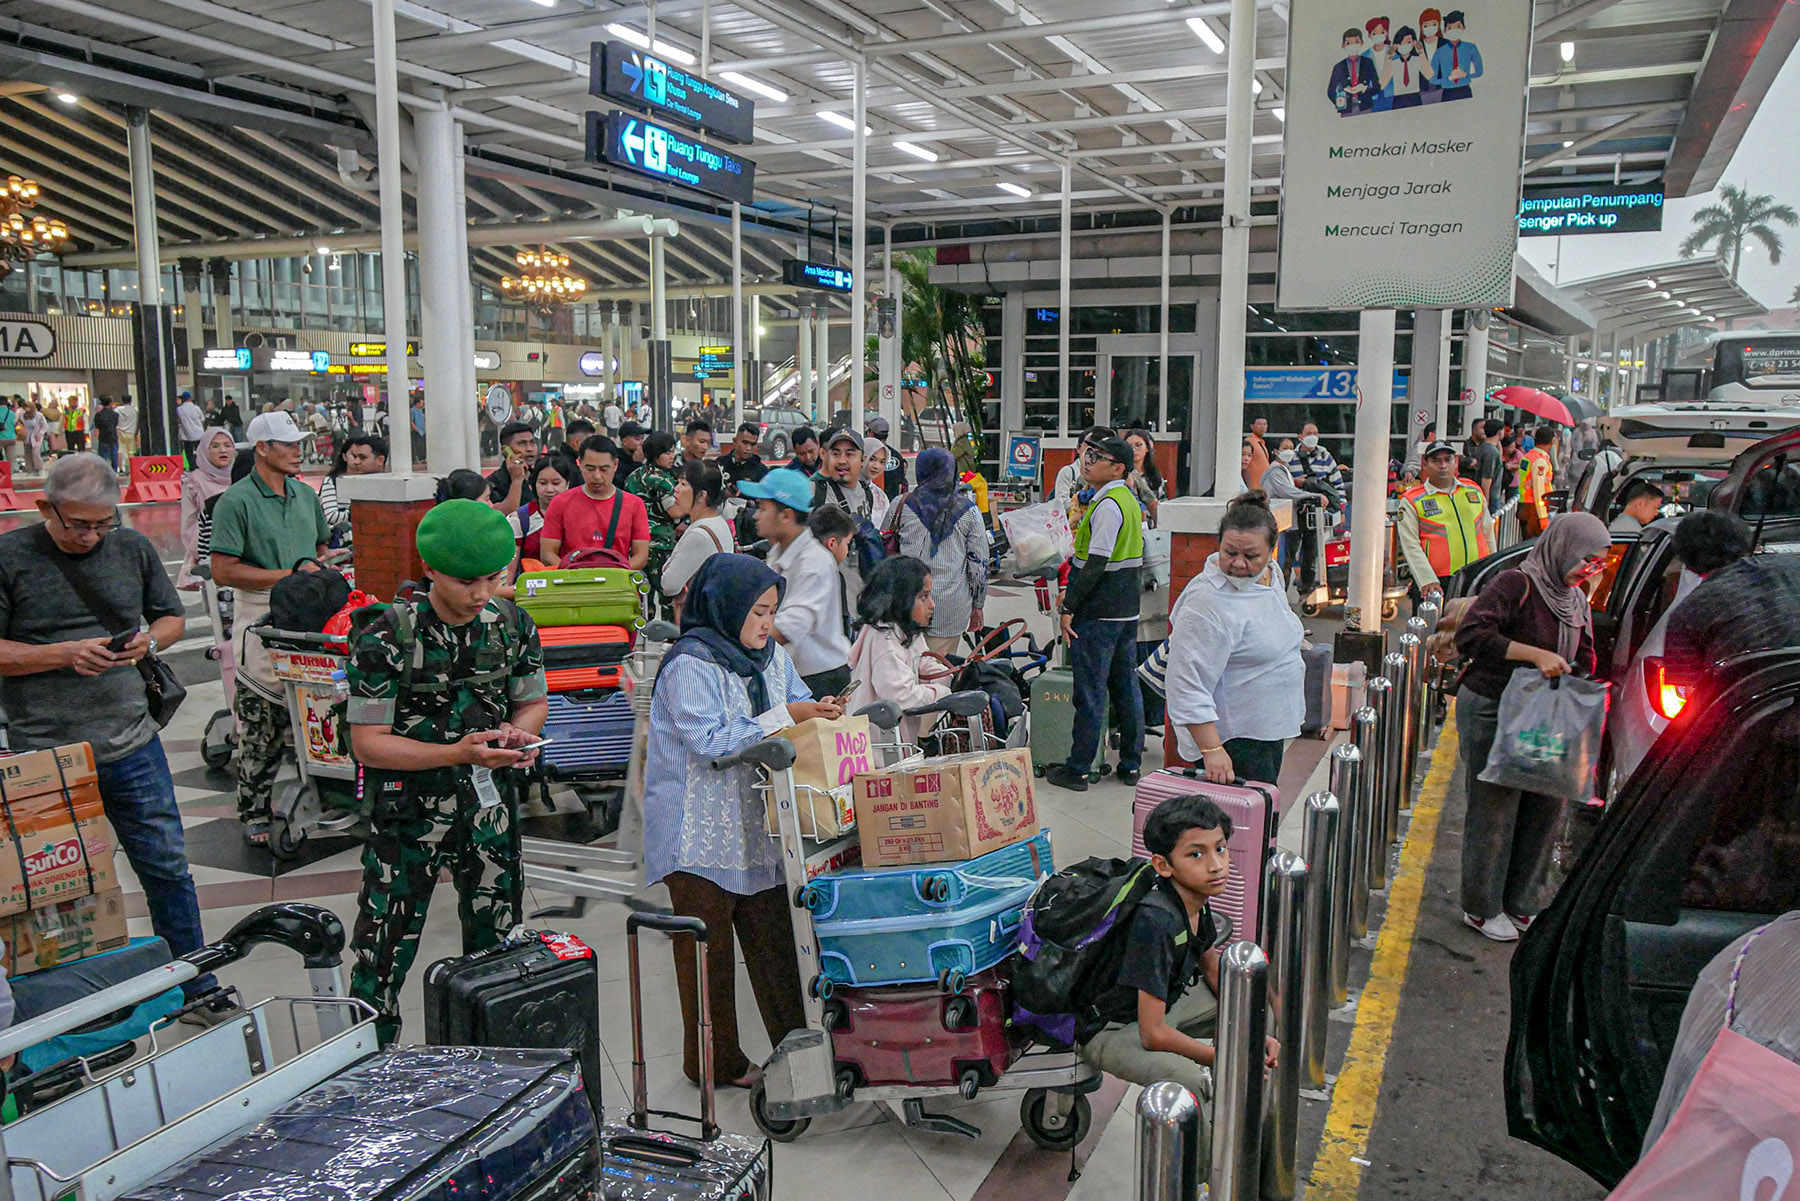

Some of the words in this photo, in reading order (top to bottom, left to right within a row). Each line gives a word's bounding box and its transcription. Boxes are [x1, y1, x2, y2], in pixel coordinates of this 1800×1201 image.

[667, 66, 684, 86] Ruang
[685, 74, 703, 93] Tunggu
[703, 83, 725, 99] Angkutan
[726, 93, 739, 108] Sewa
[667, 83, 687, 100] Khusus
[666, 99, 676, 108] Car
[687, 107, 702, 120] Lounge
[667, 135, 694, 162] Ruang
[694, 144, 723, 170] Tunggu
[724, 156, 741, 175] Taksi
[1329, 142, 1407, 159] Memakai
[1411, 139, 1474, 155] Masker
[666, 164, 678, 178] Taxi
[679, 168, 700, 185] Lounge
[1327, 183, 1400, 200] Menjaga
[1404, 180, 1453, 195] Jarak
[1582, 192, 1664, 209] Penumpang
[1566, 212, 1597, 227] Pick
[1599, 213, 1618, 228] up
[1325, 222, 1396, 237] Mencuci
[1400, 222, 1463, 237] Tangan
[1777, 360, 1788, 368] 21
[290, 654, 338, 670] KURNIA
[835, 732, 868, 757] McD
[873, 803, 898, 813] JANGAN
[901, 802, 908, 811] DI
[910, 799, 939, 810] BANTING
[25, 840, 79, 875] SunCo
[45, 870, 77, 885] GORENG
